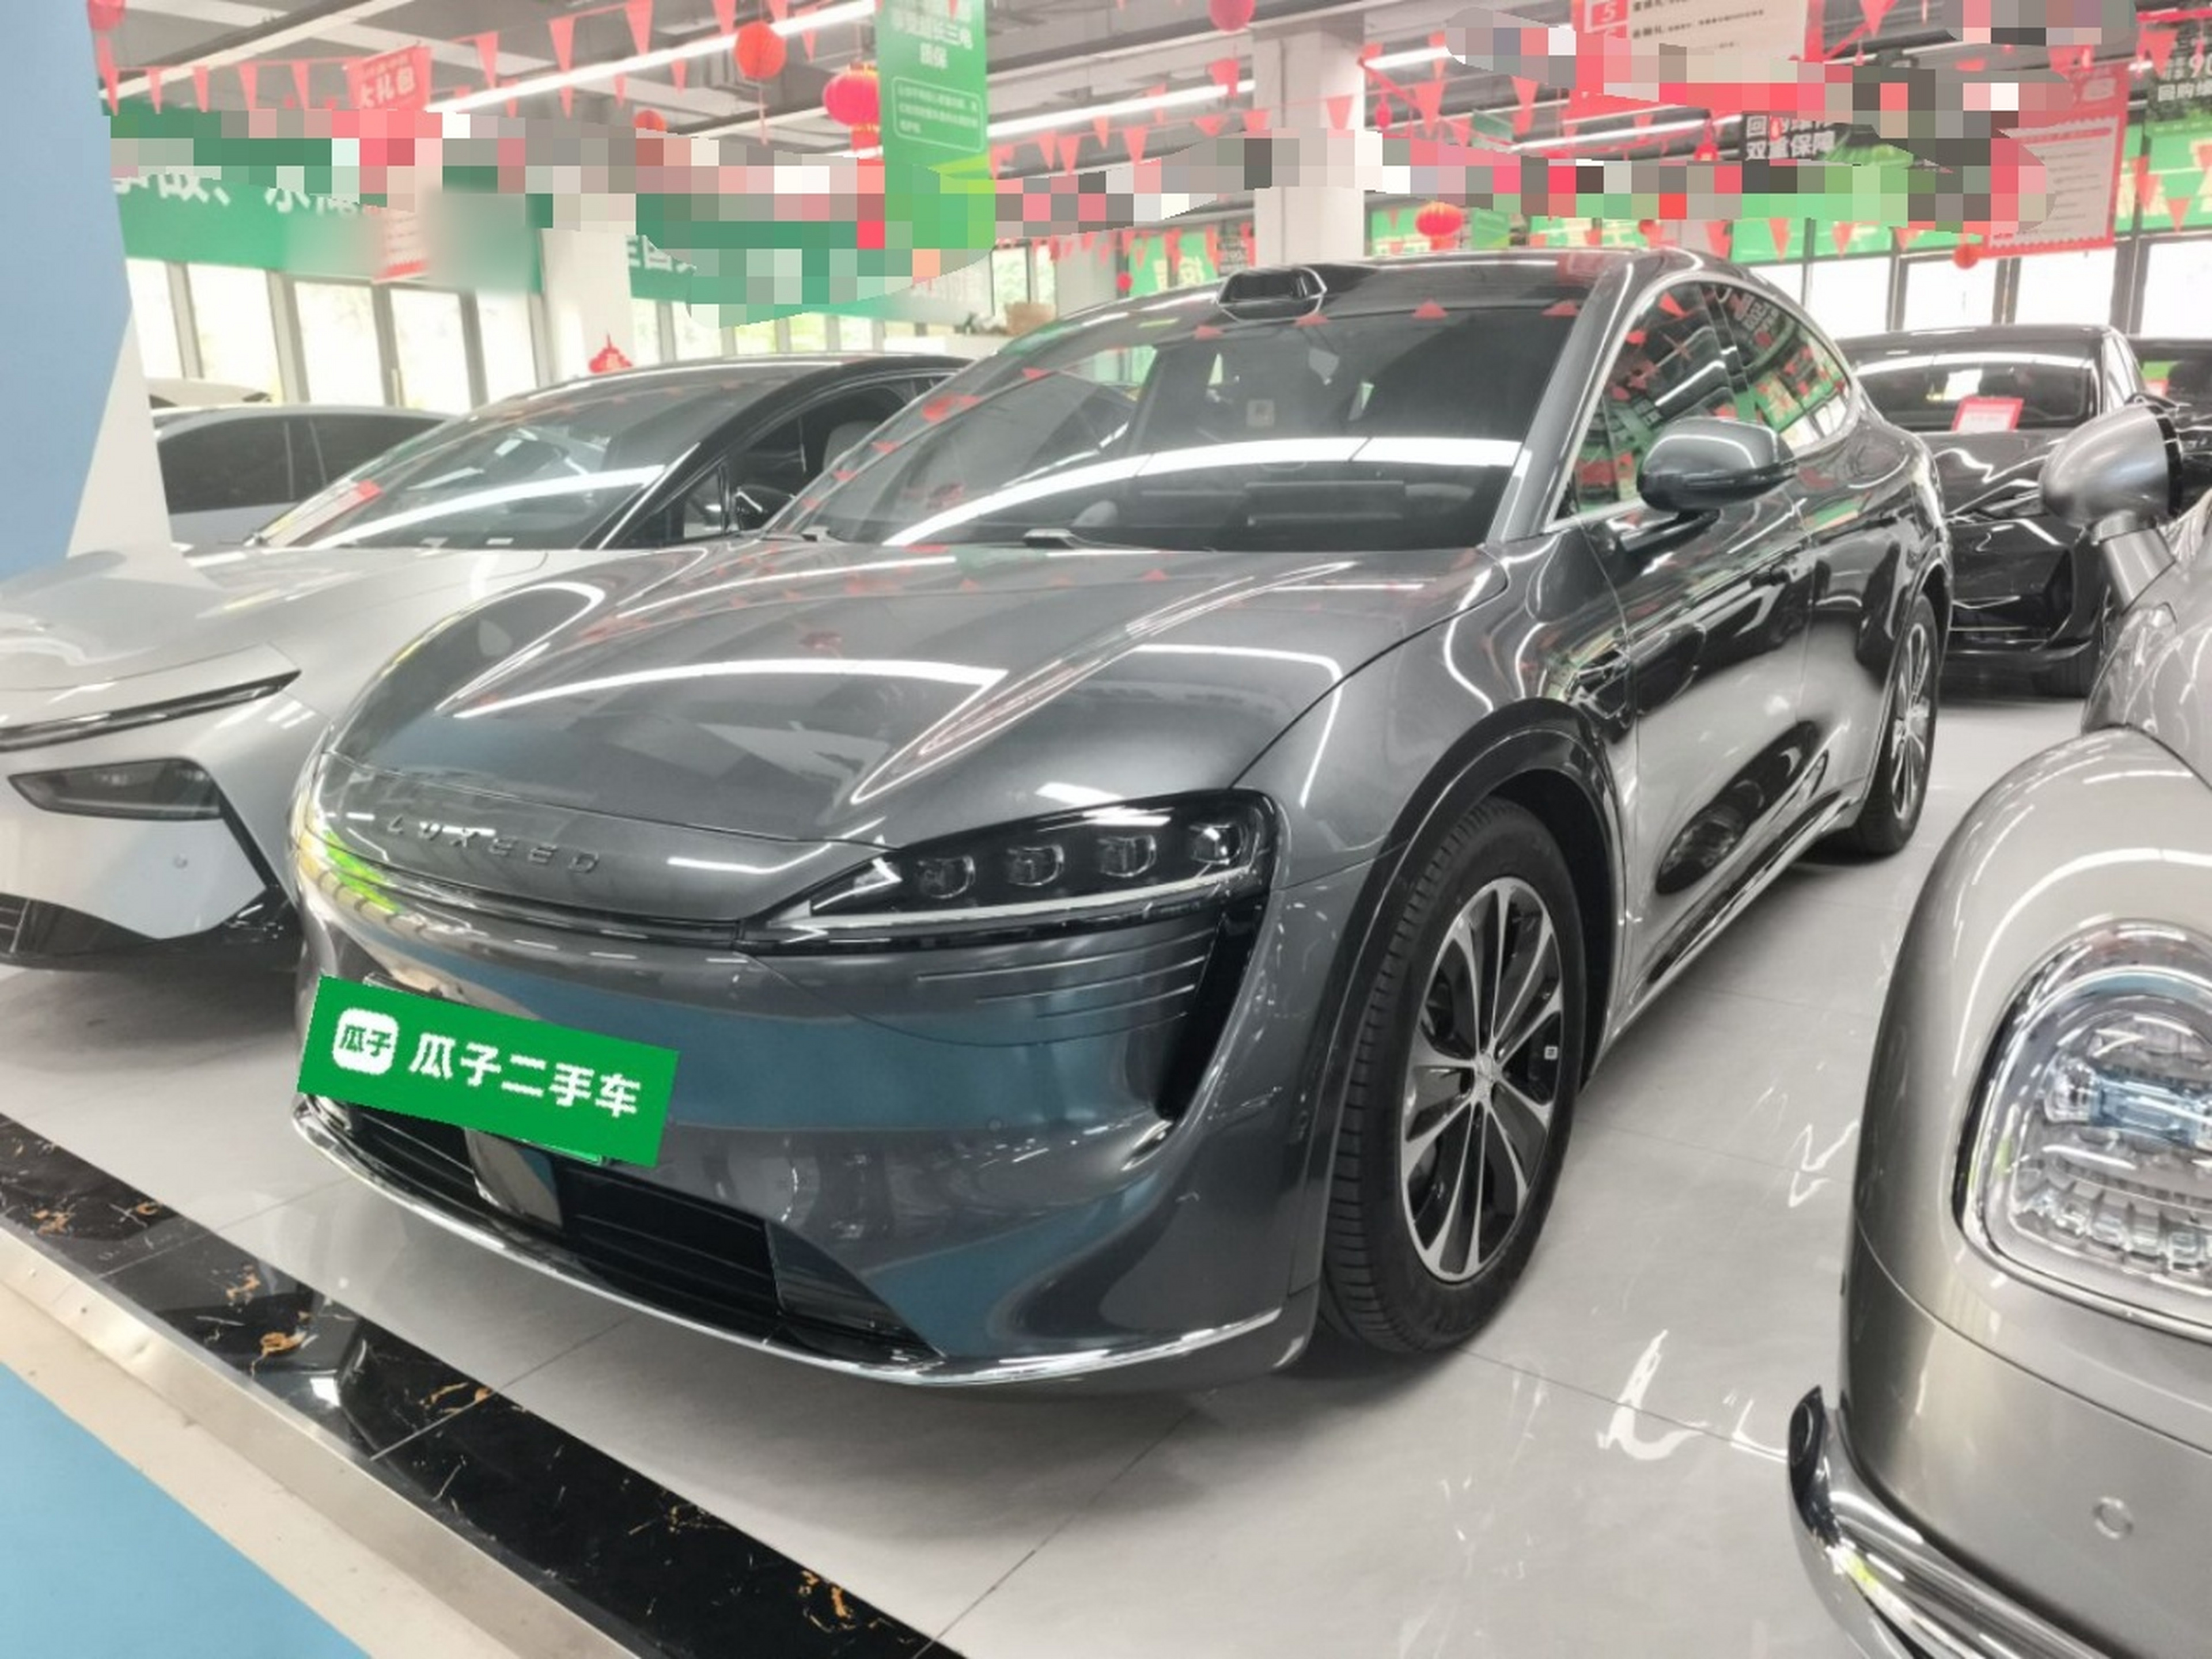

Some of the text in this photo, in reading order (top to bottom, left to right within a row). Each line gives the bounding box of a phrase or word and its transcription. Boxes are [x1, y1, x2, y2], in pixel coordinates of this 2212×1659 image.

[359, 65, 415, 108] 大礼包
[388, 814, 600, 873] LUXEED
